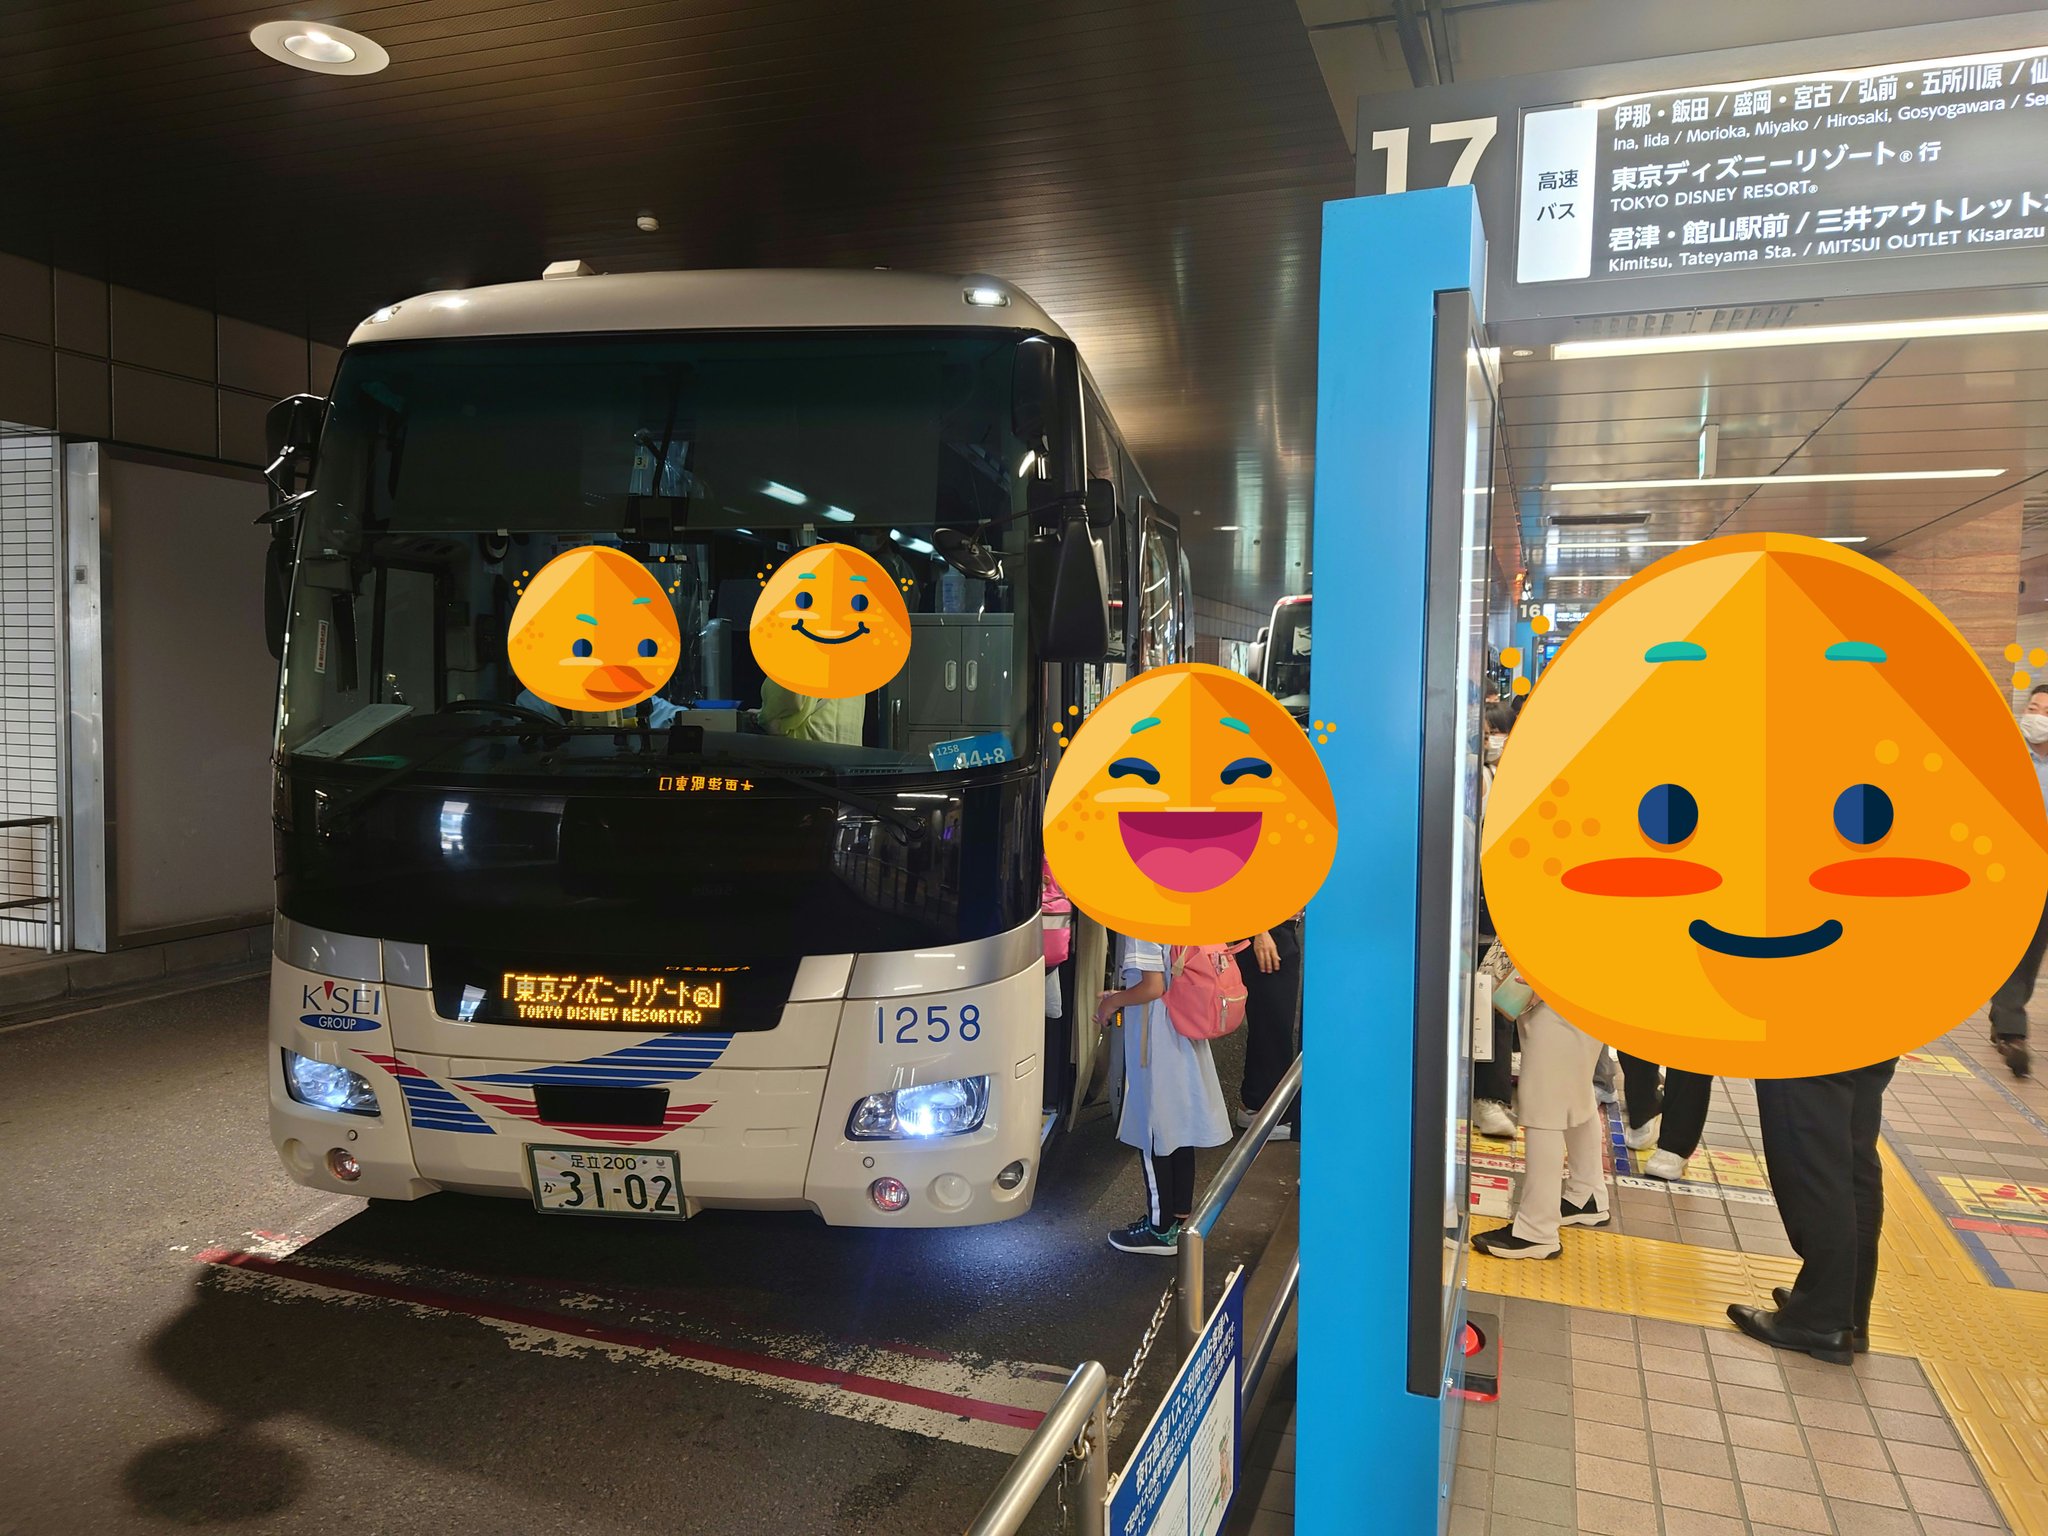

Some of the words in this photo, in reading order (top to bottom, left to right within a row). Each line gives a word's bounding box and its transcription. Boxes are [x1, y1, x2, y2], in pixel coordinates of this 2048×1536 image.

[1614, 97, 1709, 131] 伊那・飯田
[1733, 83, 1833, 118] 盛岡・宮古
[1858, 64, 2004, 104] 弘前・五所川原
[1613, 137, 1639, 152] Ina,
[1643, 132, 1670, 147] Iida
[1686, 124, 1750, 144] Morioka,
[1754, 118, 1809, 139] Miyako
[1826, 108, 1893, 129] Hirosaki,
[1897, 96, 2006, 123] Gosyogawara
[1372, 116, 1498, 195] 17
[1537, 168, 1579, 192] 高速
[1536, 202, 1576, 222] バス
[1610, 193, 1669, 213] TOKYO
[1675, 186, 1738, 206] DISNEY
[1608, 212, 1790, 252] 君津・館山駅前
[1815, 191, 2048, 234] 三井アウトレット
[1608, 255, 1673, 273] Kimitsu,
[1679, 247, 1759, 267] Tateyama
[1764, 244, 1797, 260] Sta.
[1817, 236, 1881, 256] MITSUI
[1886, 229, 1962, 250] OUTLET
[1966, 225, 2046, 244] Kisarazu
[1520, 604, 1541, 618] 16
[936, 744, 960, 757] 1258
[953, 747, 1006, 770] 44+8
[318, 1016, 357, 1030] GROUP
[517, 1004, 563, 1020] TOKYO
[566, 1005, 619, 1022] DISNEY
[622, 1008, 703, 1025] RESORT(R)
[877, 1004, 982, 1045] 1258
[543, 1181, 557, 1194] か
[560, 1170, 676, 1212] 31-02
